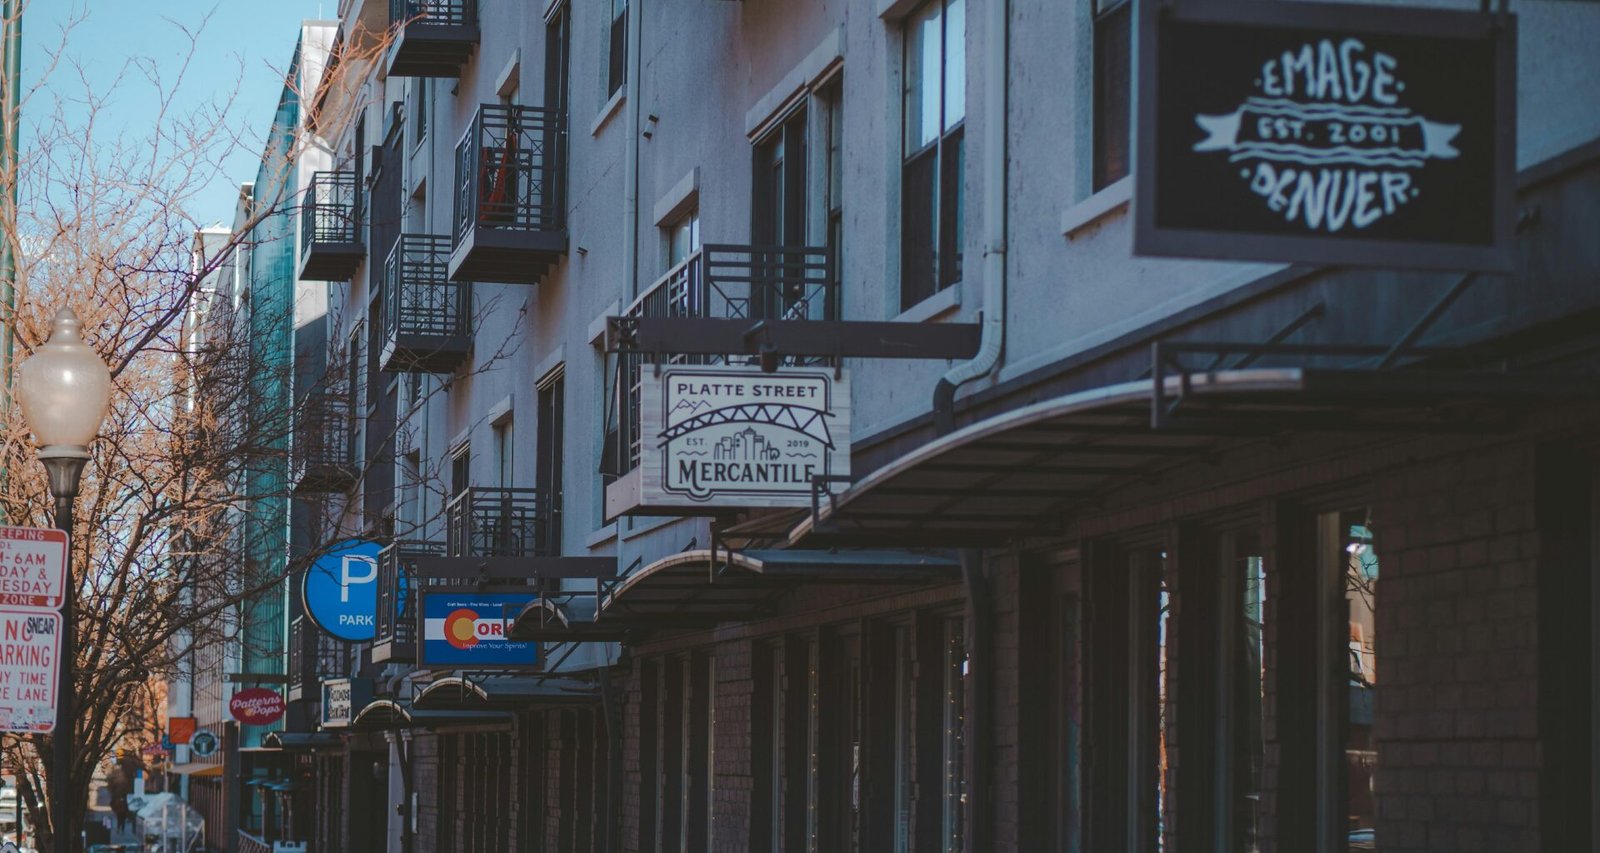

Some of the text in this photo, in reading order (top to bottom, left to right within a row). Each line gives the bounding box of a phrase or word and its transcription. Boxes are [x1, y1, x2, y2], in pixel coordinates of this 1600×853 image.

[1262, 37, 1398, 104] EMAGE
[1257, 117, 1399, 143] EST. 2001
[1251, 162, 1411, 232] DENVER
[677, 383, 818, 398] PLATTE STREET
[686, 437, 810, 448] EST. 2019
[679, 460, 815, 490] MERCANTILE
[341, 554, 377, 602] P
[0, 580, 52, 593] ESDAY
[3, 594, 35, 605] ZONE
[339, 615, 374, 626] PARK
[489, 642, 503, 650] Your
[20, 672, 47, 686] TIME
[17, 687, 48, 701] LANE
[232, 696, 281, 709] Patterns
[253, 705, 280, 717] Pops
